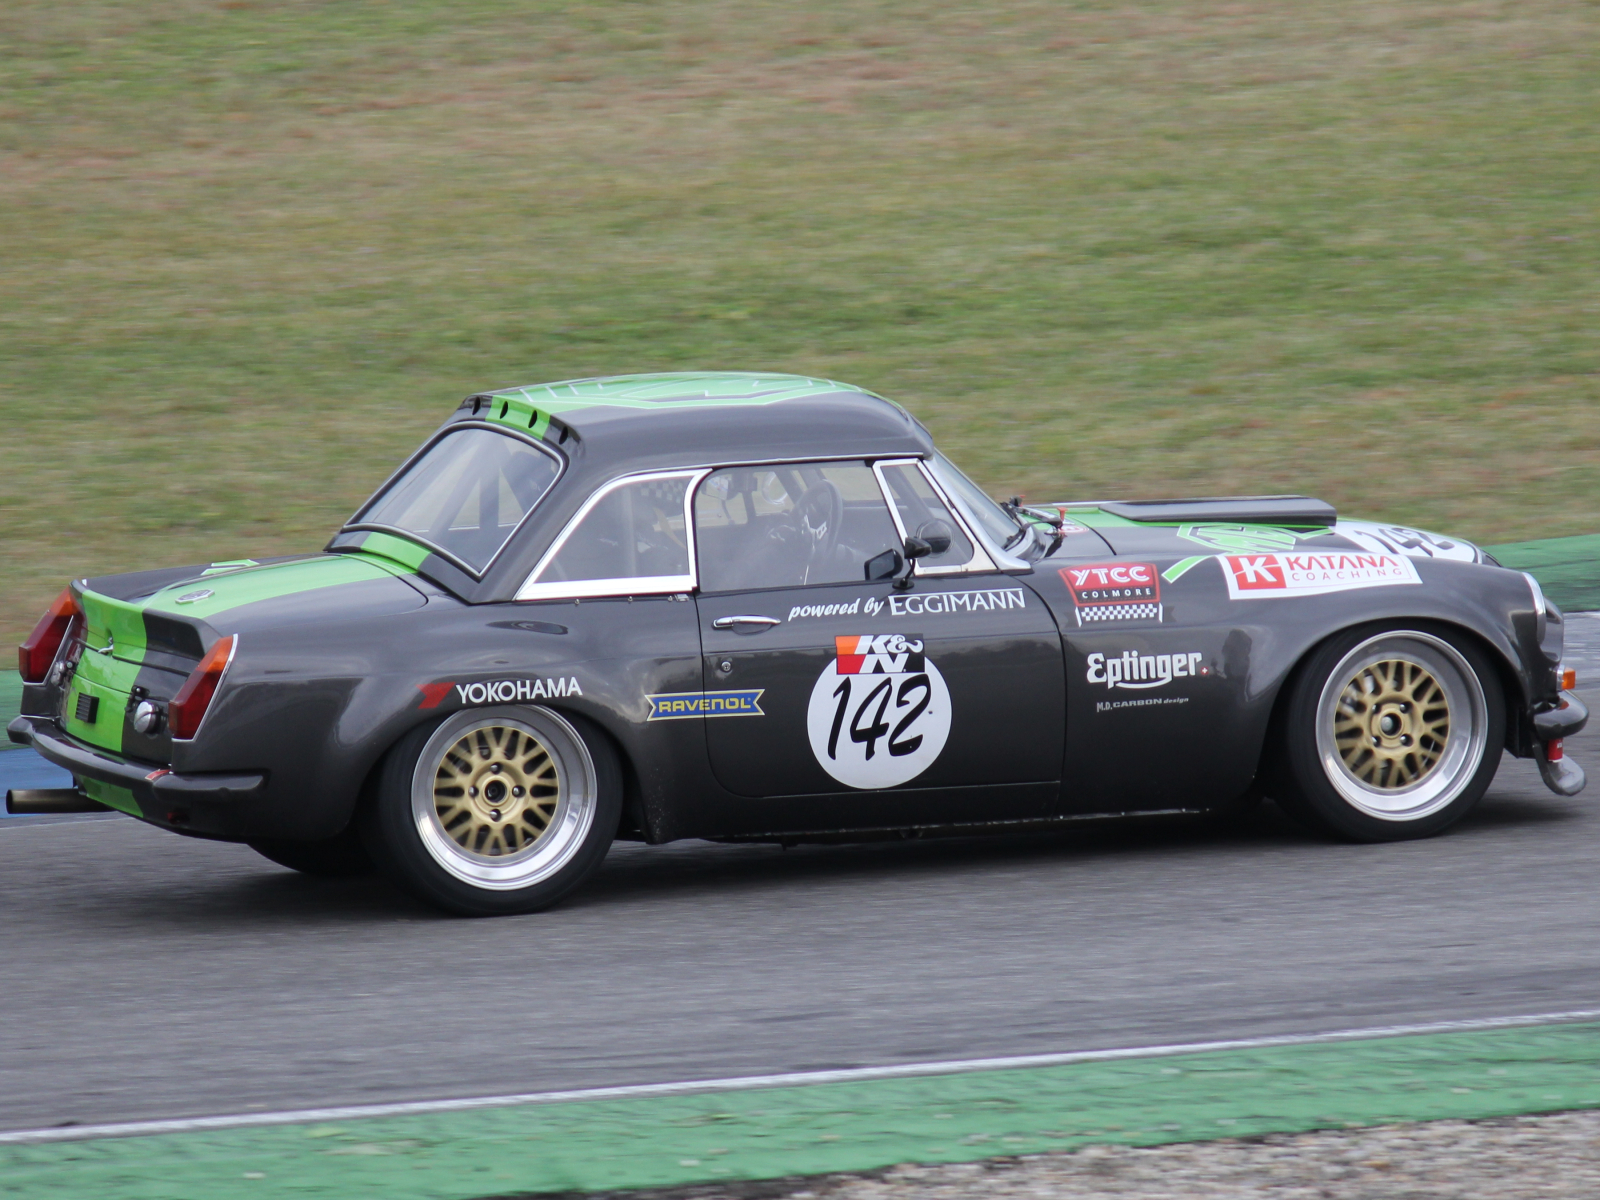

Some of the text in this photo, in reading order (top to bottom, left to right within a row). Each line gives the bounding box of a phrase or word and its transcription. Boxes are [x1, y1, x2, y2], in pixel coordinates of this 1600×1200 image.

[1354, 527, 1455, 558] 142
[1285, 555, 1399, 571] KATANA
[1070, 566, 1150, 586] YTCC
[1291, 567, 1402, 582] COACHING
[1082, 588, 1151, 599] COLMORE
[788, 588, 1026, 622] powered by EGGIMANN
[1086, 650, 1203, 690] Eptinger
[456, 676, 583, 704] YOKOHAMA
[658, 697, 751, 713] RAVENOL
[1096, 702, 1113, 713] M.D.
[1113, 698, 1163, 708] CARBON
[827, 673, 932, 761] 142
